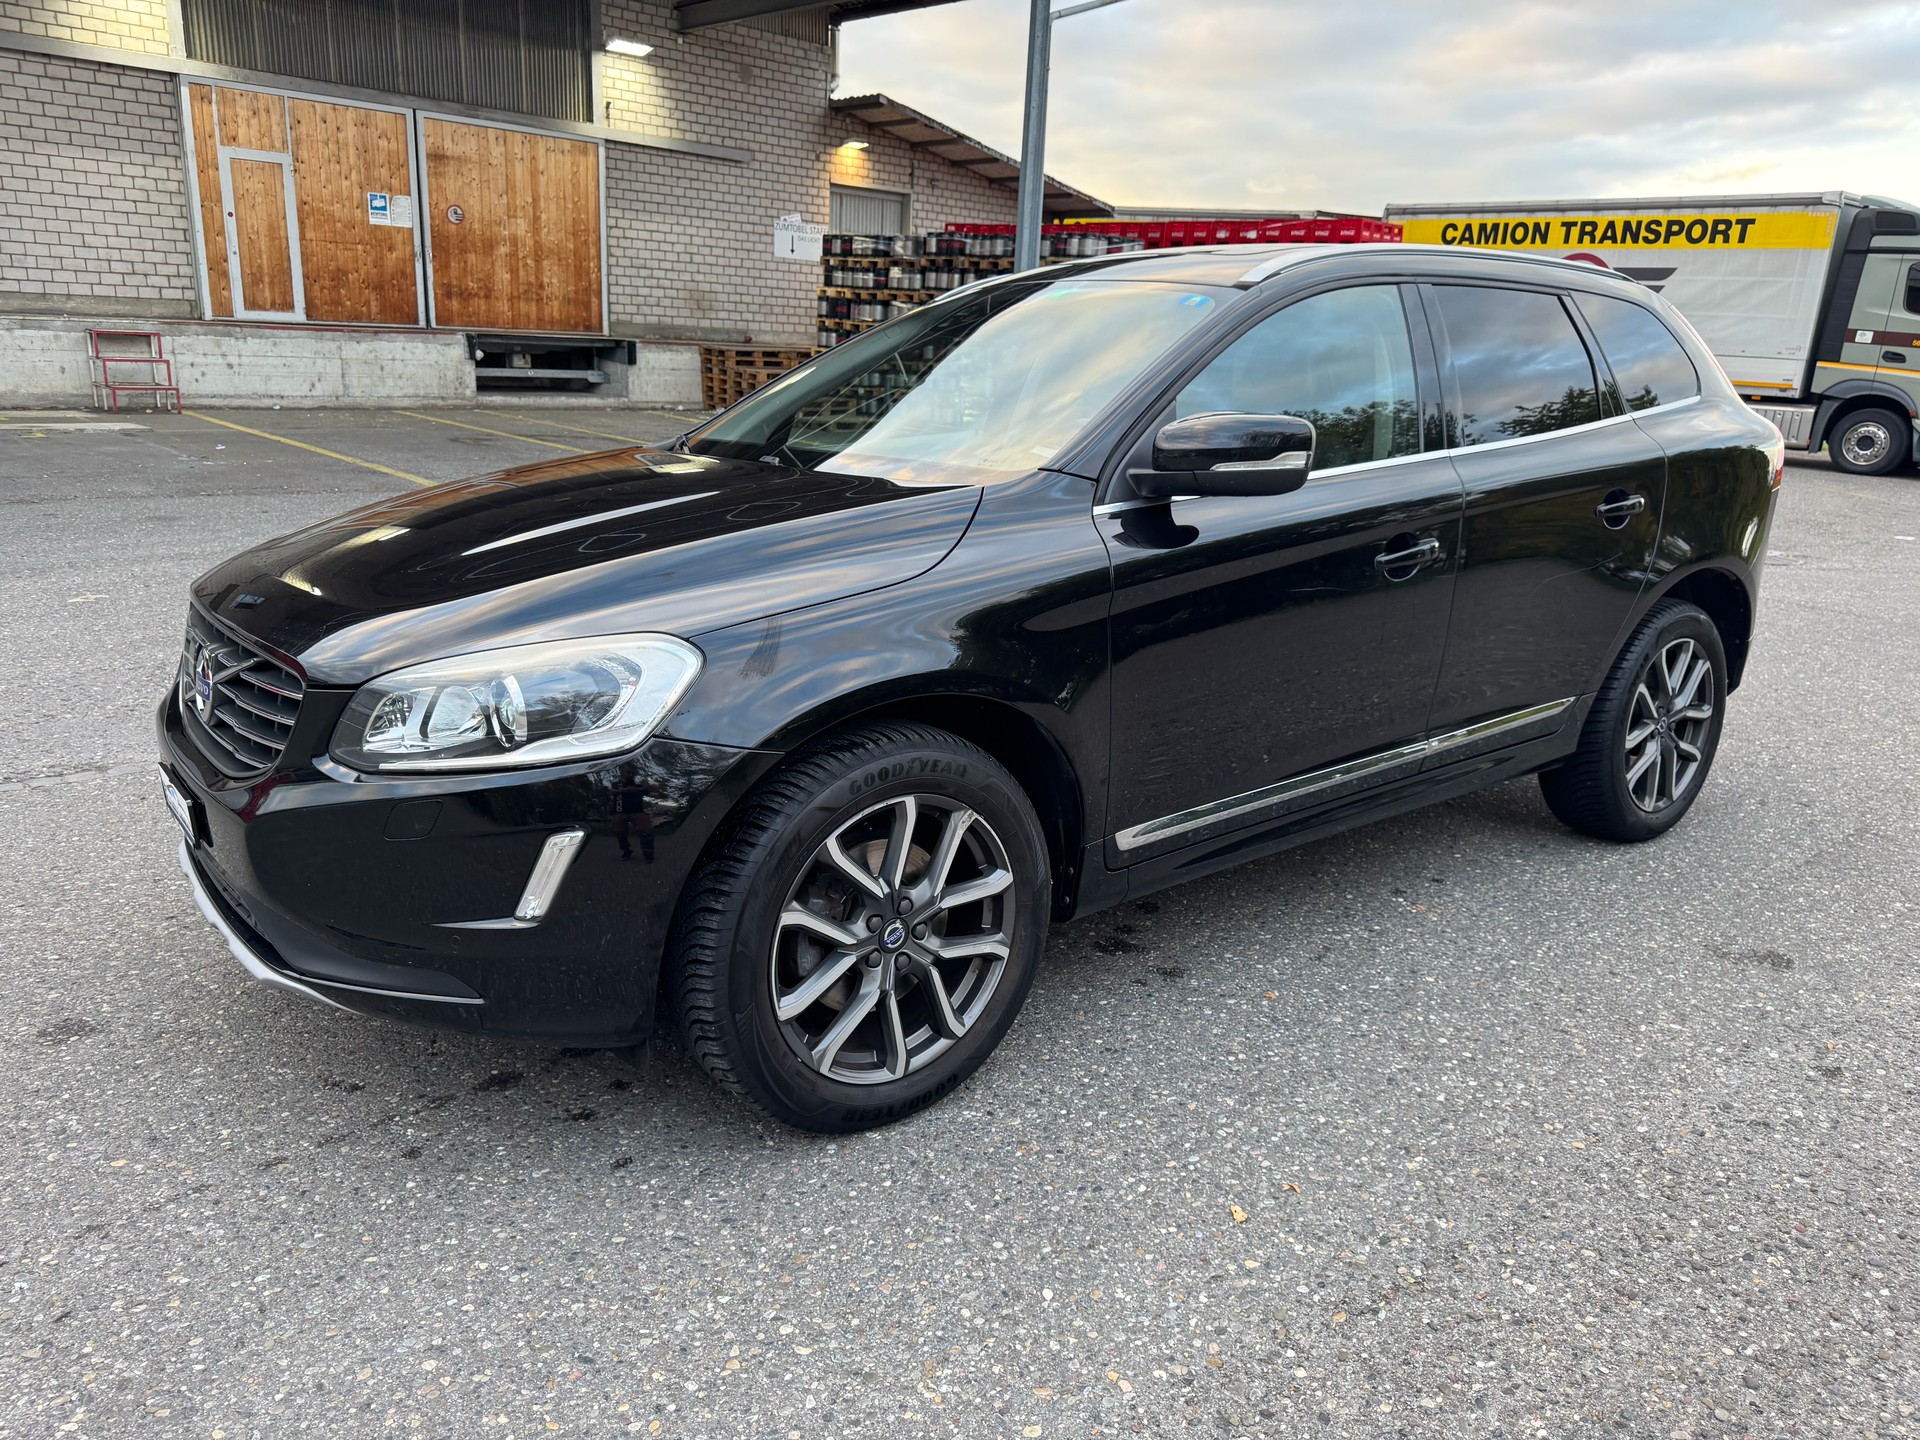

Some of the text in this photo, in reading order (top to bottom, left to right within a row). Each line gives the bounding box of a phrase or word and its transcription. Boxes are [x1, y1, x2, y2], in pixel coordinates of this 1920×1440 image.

[775, 222, 809, 234] ZUMTOBEL
[1441, 218, 1756, 246] CAMION TRANSPORT
[849, 757, 968, 796] GOODYEAR
[886, 928, 904, 943] VOLVO
